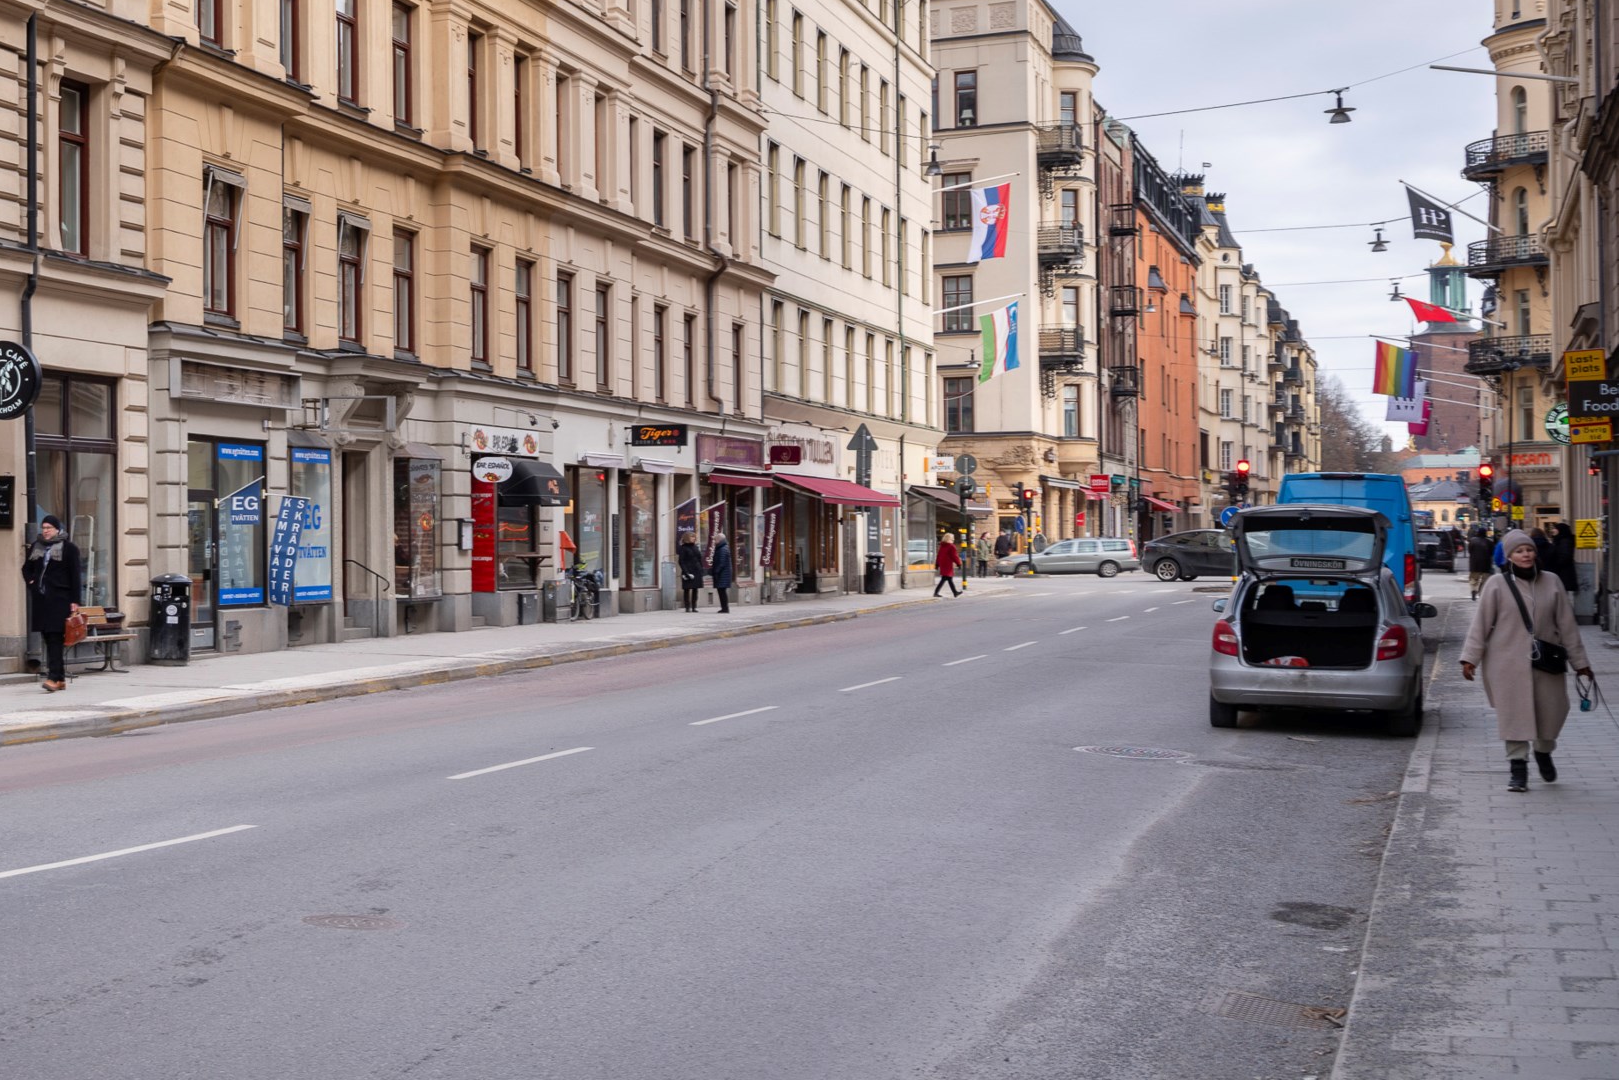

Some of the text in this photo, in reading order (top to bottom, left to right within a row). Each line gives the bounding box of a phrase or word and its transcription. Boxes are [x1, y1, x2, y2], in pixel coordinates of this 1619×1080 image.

[6, 349, 28, 370] CAFÉ
[1570, 355, 1600, 364] Last-
[1571, 365, 1600, 375] plats
[232, 496, 258, 511] EG
[232, 514, 258, 522] TVÄTTEN
[304, 504, 322, 530] EG
[1294, 559, 1343, 568] ÖVNINGSKÖR
